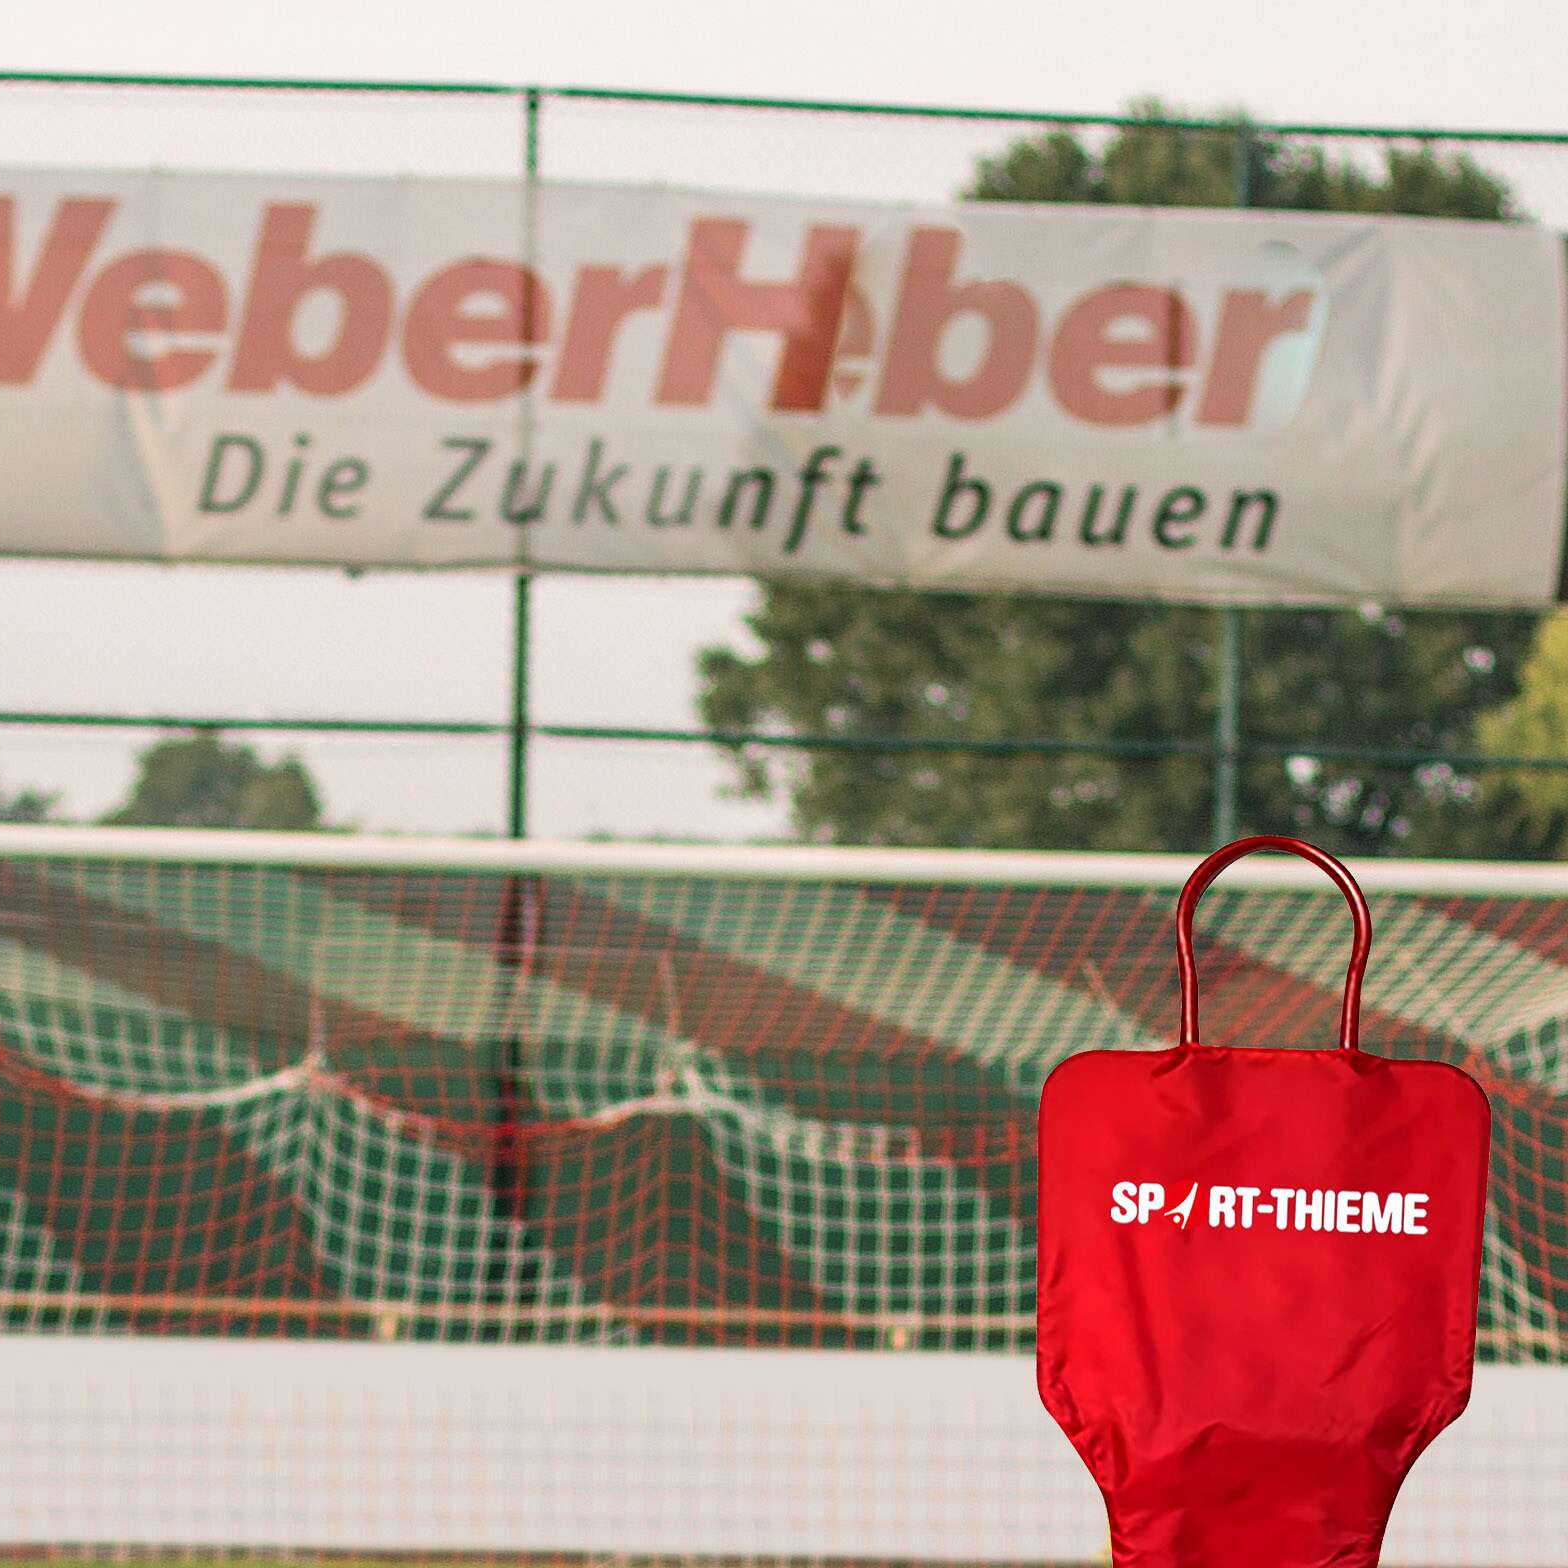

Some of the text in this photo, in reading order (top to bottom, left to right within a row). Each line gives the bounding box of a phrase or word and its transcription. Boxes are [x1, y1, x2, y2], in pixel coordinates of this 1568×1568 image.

[197, 433, 1280, 554] Die Zukunft bauen
[1110, 1181, 1430, 1235] SPRT-THIEME
